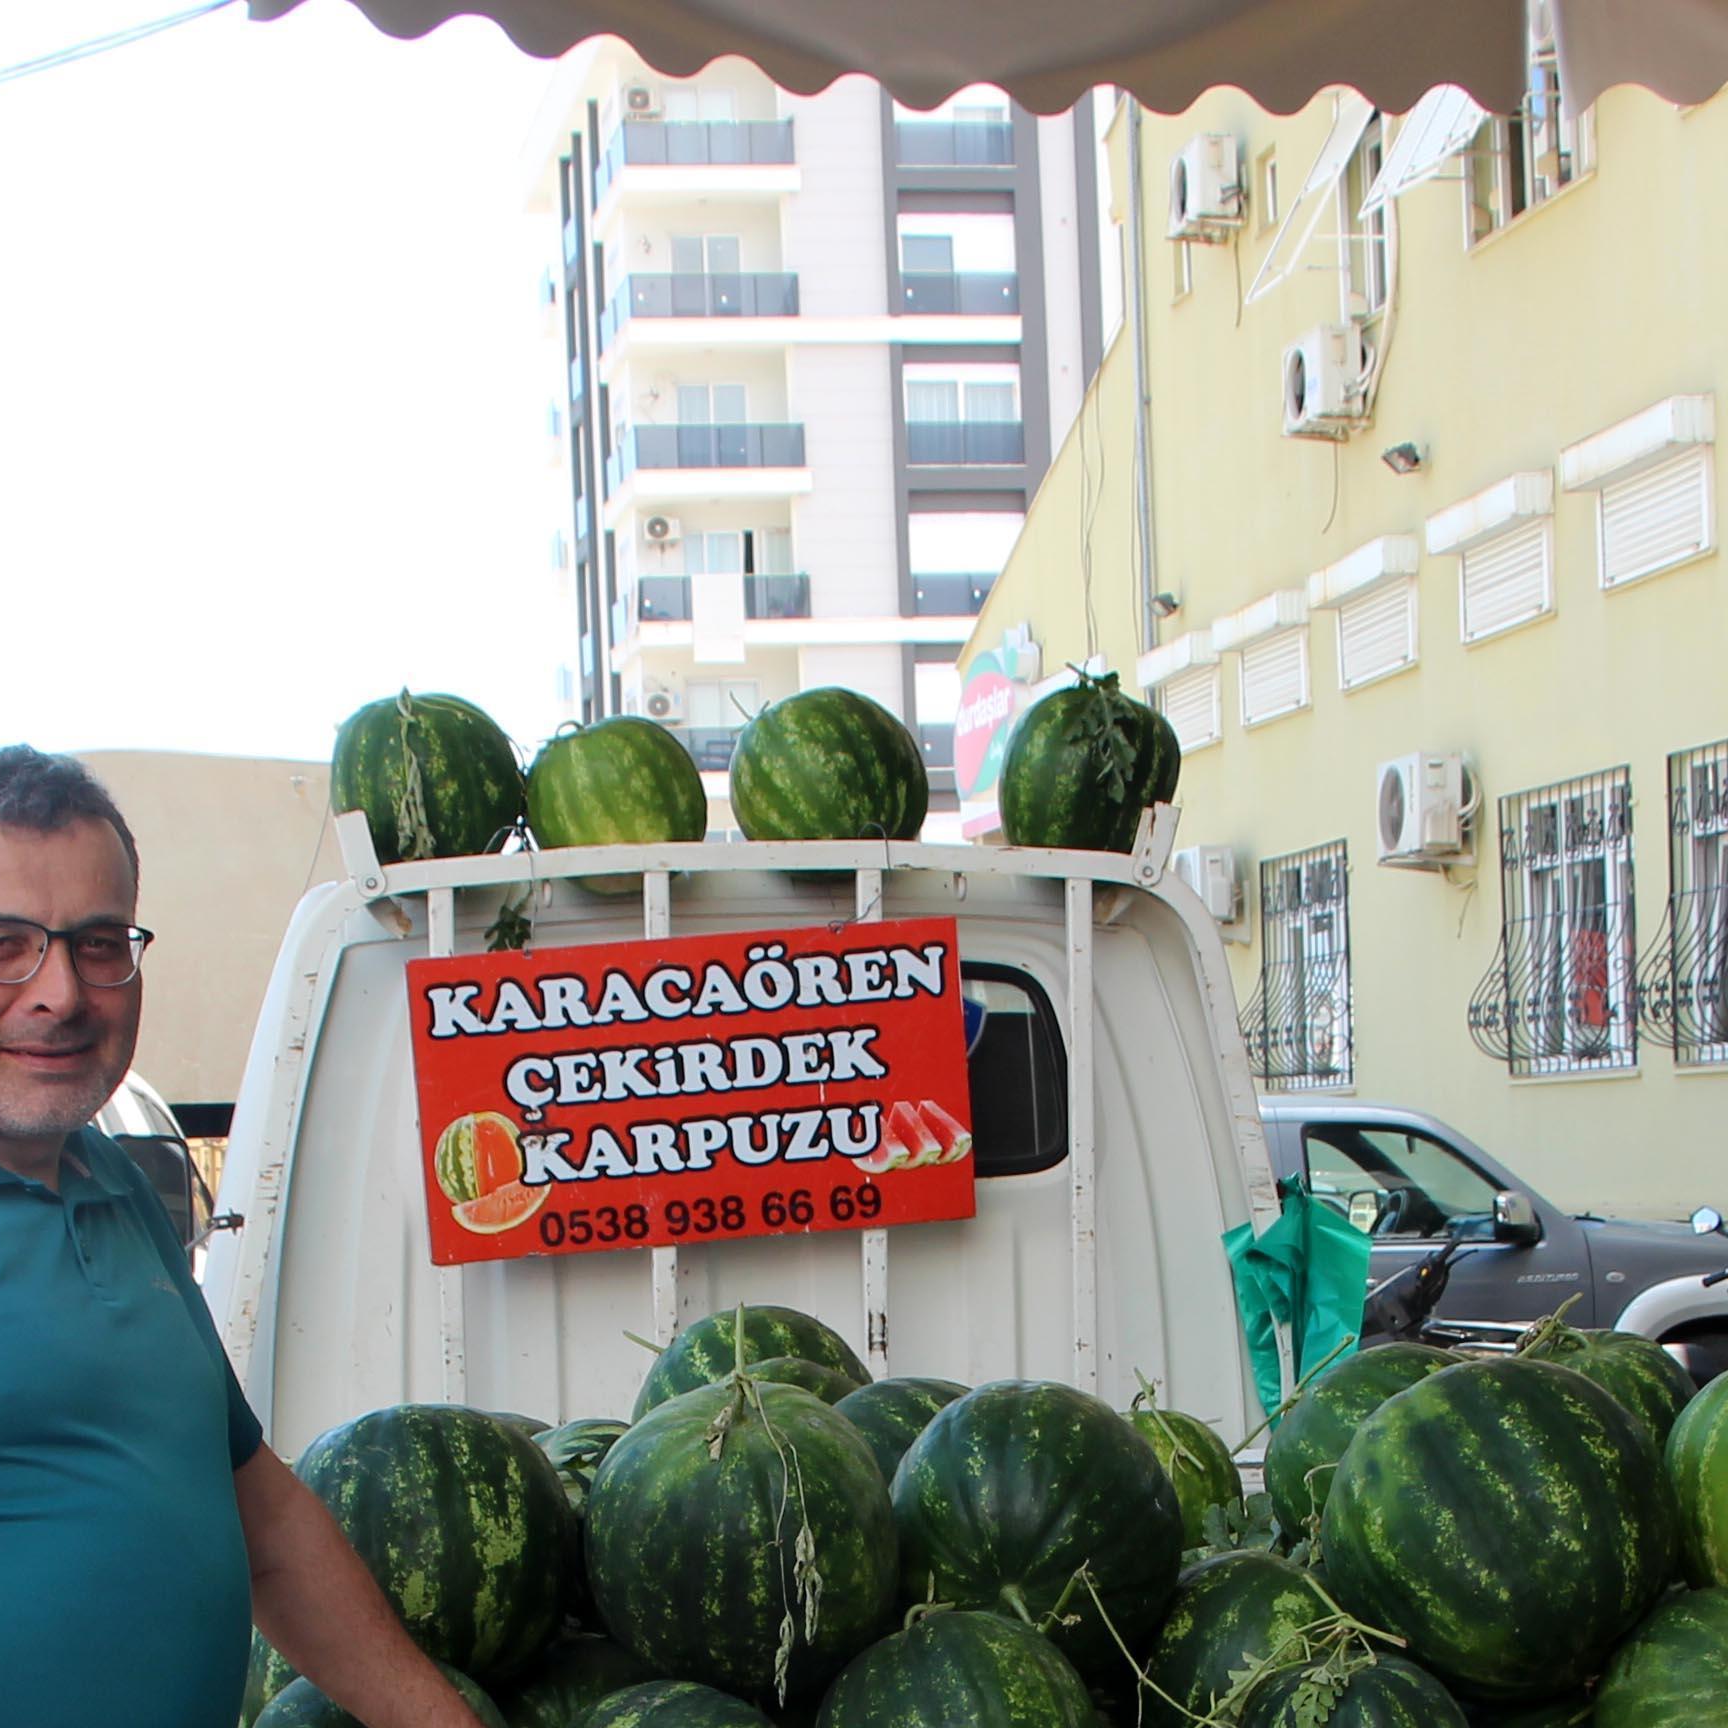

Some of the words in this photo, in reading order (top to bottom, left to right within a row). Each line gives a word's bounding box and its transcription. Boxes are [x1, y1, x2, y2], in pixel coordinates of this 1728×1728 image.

[429, 945, 944, 1038] KARACAÖREN
[522, 1105, 881, 1184] KARPUZU
[539, 1204, 650, 1248] 0538
[665, 1195, 746, 1236] 938
[761, 1188, 816, 1227] 66
[829, 1184, 882, 1221] 69
